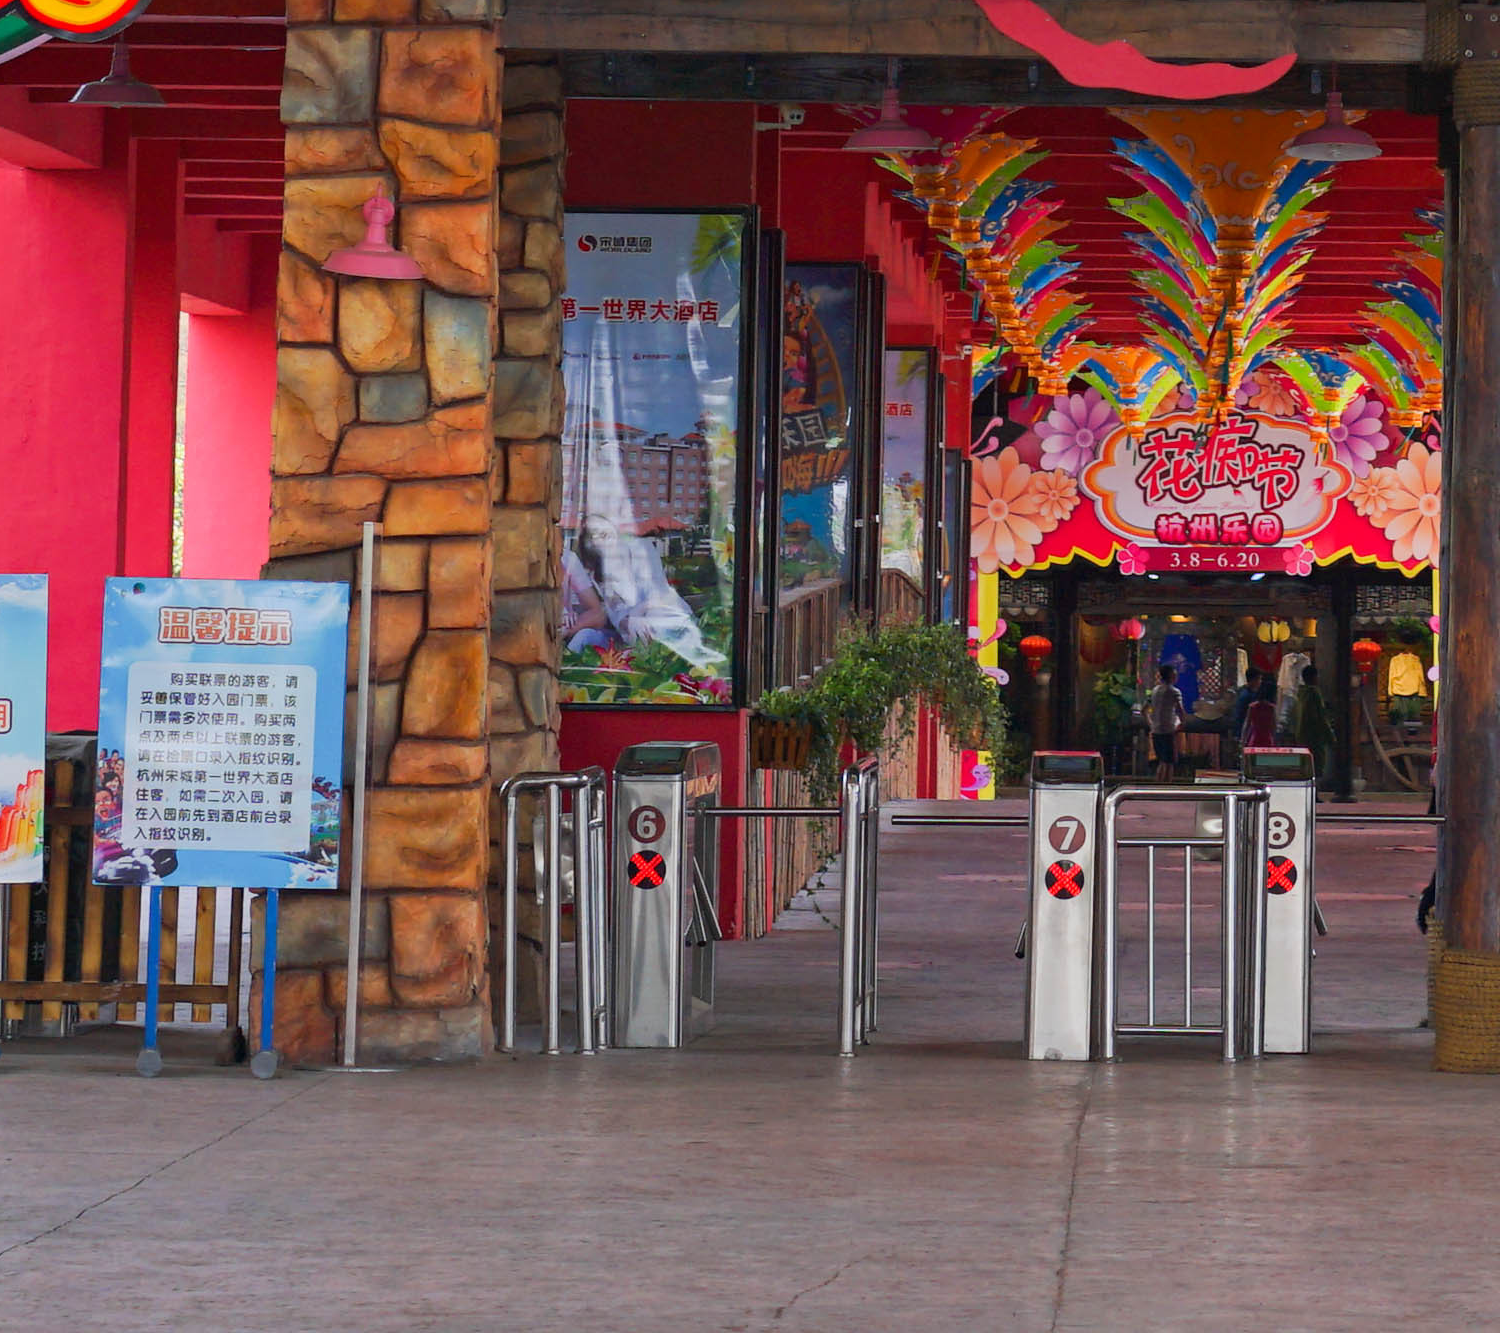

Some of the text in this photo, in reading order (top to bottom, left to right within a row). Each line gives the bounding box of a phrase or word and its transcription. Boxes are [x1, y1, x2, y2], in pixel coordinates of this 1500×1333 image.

[1138, 416, 1303, 508] 花痴节
[1156, 513, 1283, 545] 杭州乐园
[158, 606, 294, 646] 温馨提示
[635, 809, 658, 840] 6
[1054, 820, 1080, 851] 7
[1268, 816, 1290, 845] 8
